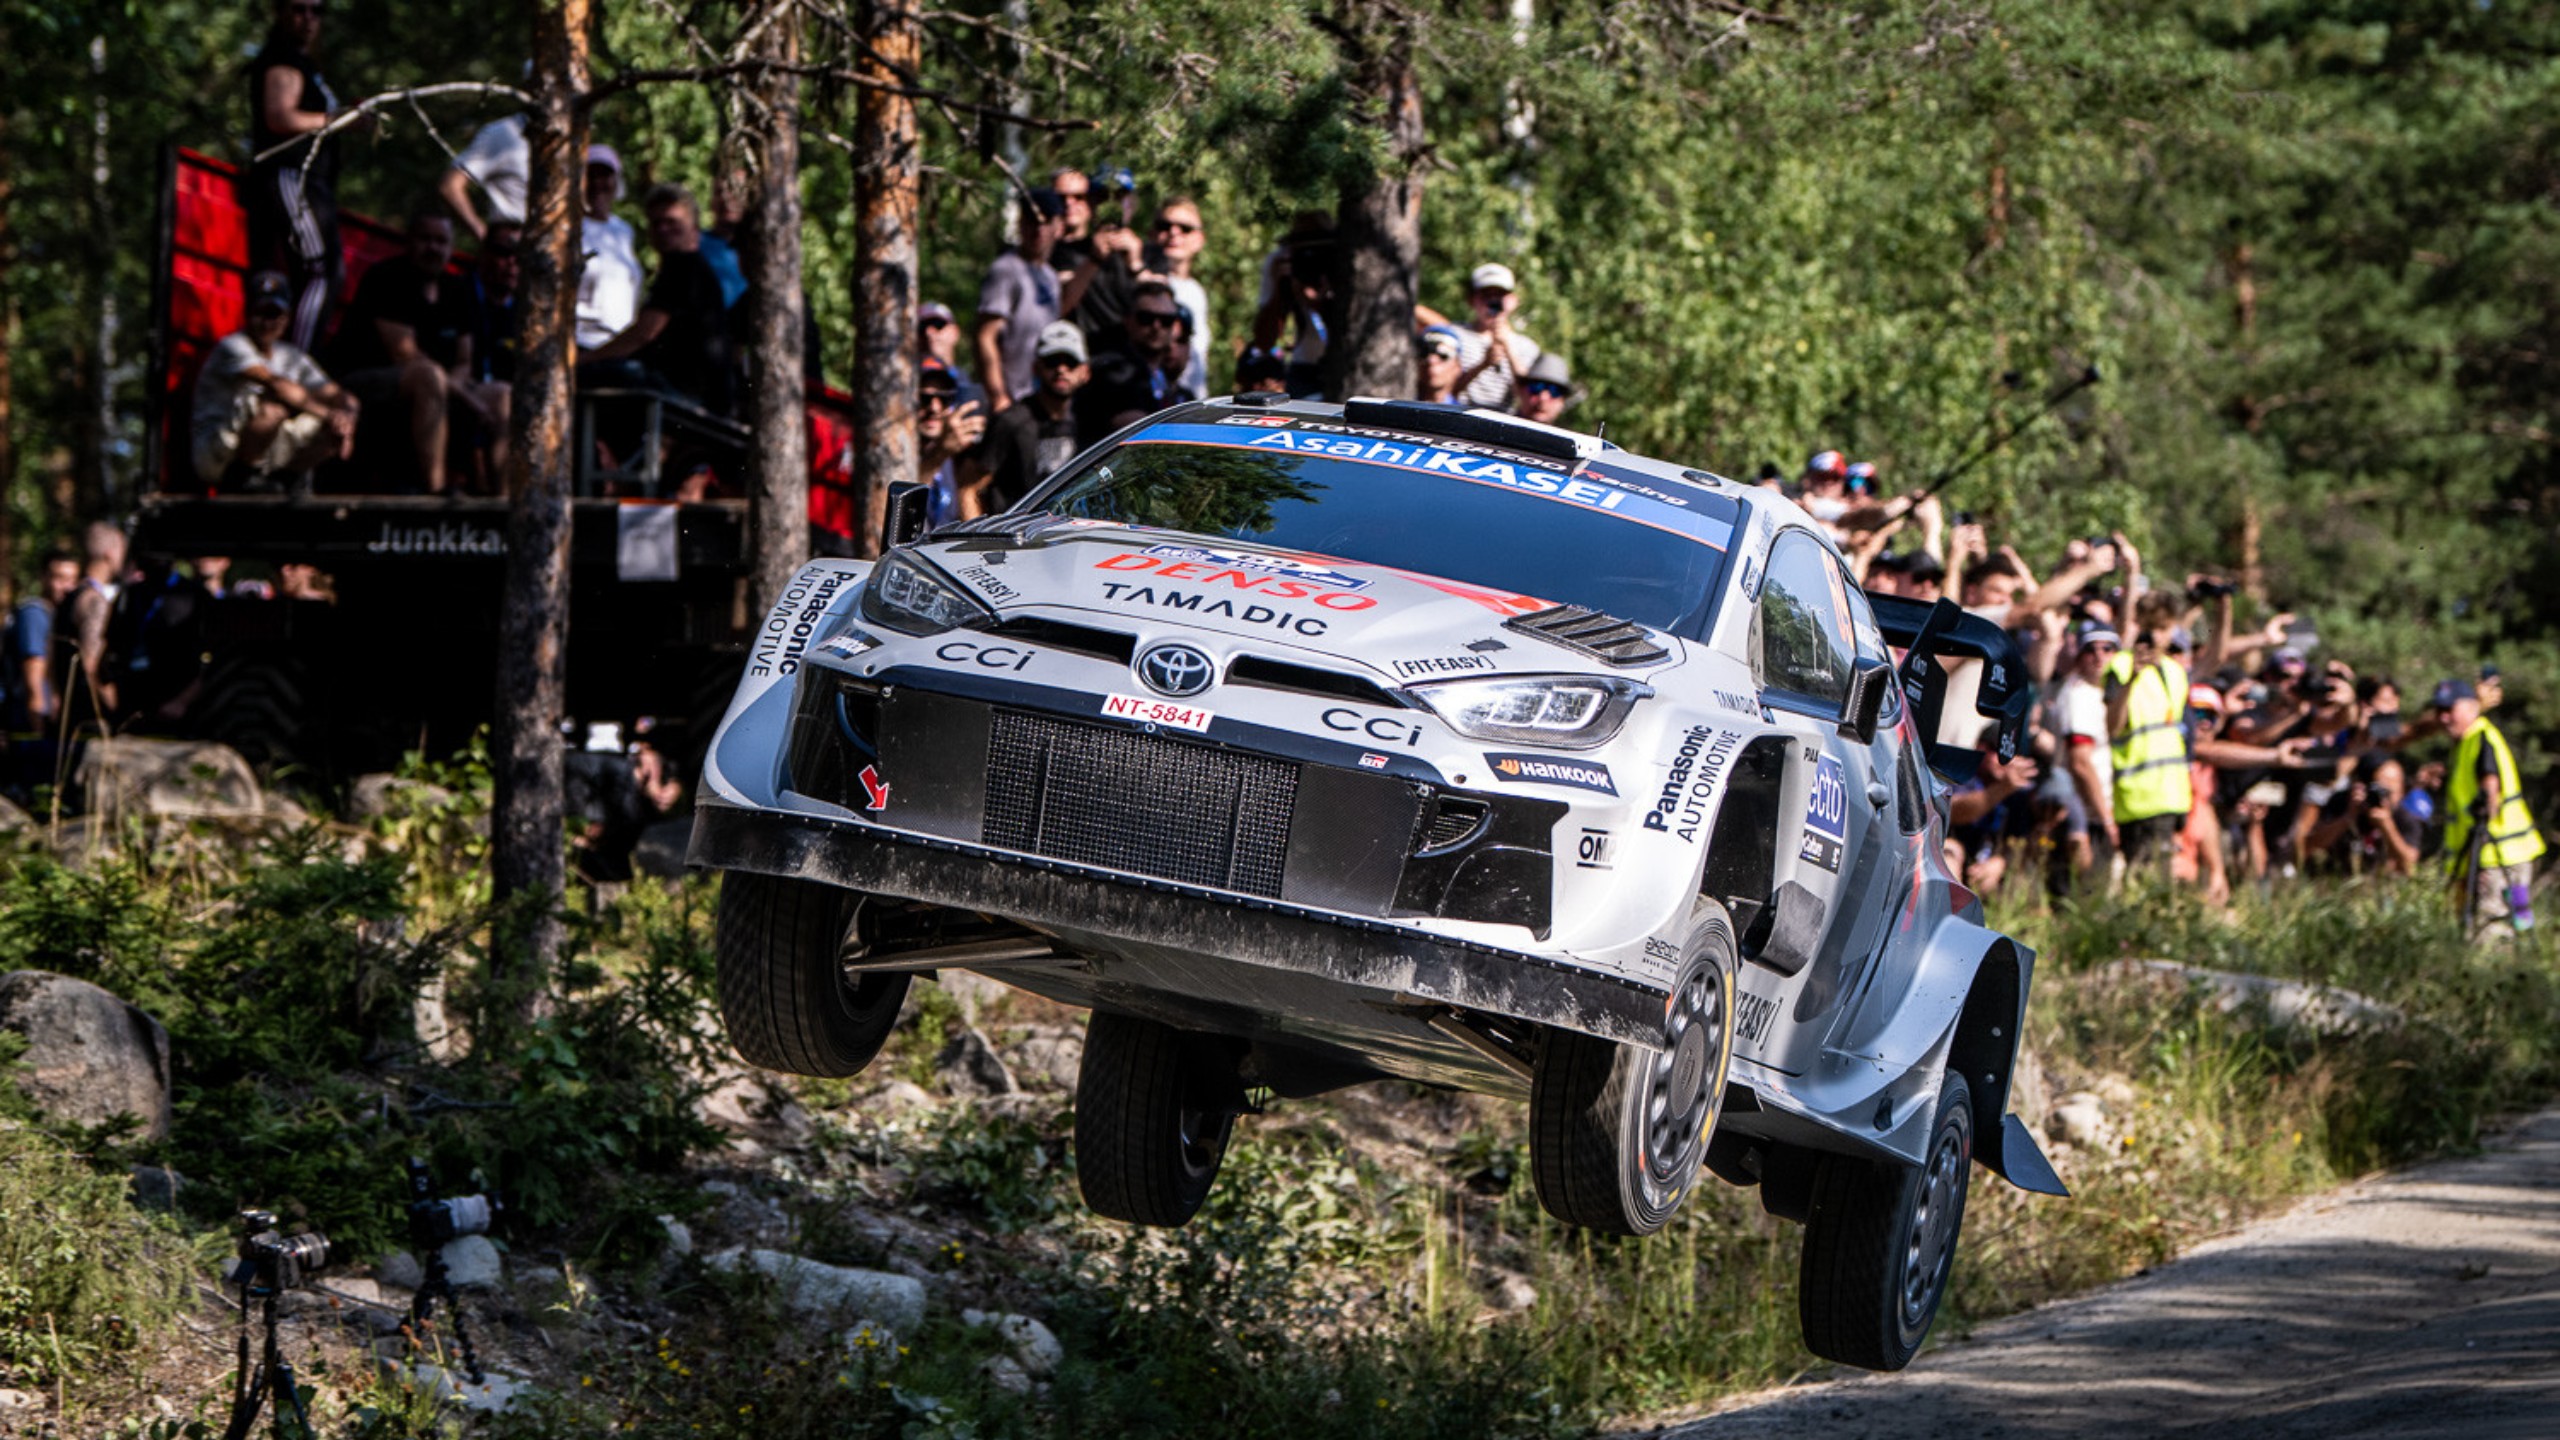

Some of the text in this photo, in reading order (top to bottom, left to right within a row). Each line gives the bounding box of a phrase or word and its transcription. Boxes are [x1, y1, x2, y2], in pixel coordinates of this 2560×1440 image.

[367, 520, 508, 556] Junkka
[750, 566, 825, 678] AUTOMOTIVE
[778, 570, 858, 676] Panasonic
[1094, 553, 1378, 612] DENSO
[1102, 582, 1329, 637] TAMADIC
[1108, 696, 1206, 728] NT-5841
[1643, 724, 1713, 832] Panasonic
[1677, 729, 1742, 844] AUTOMOTIVE
